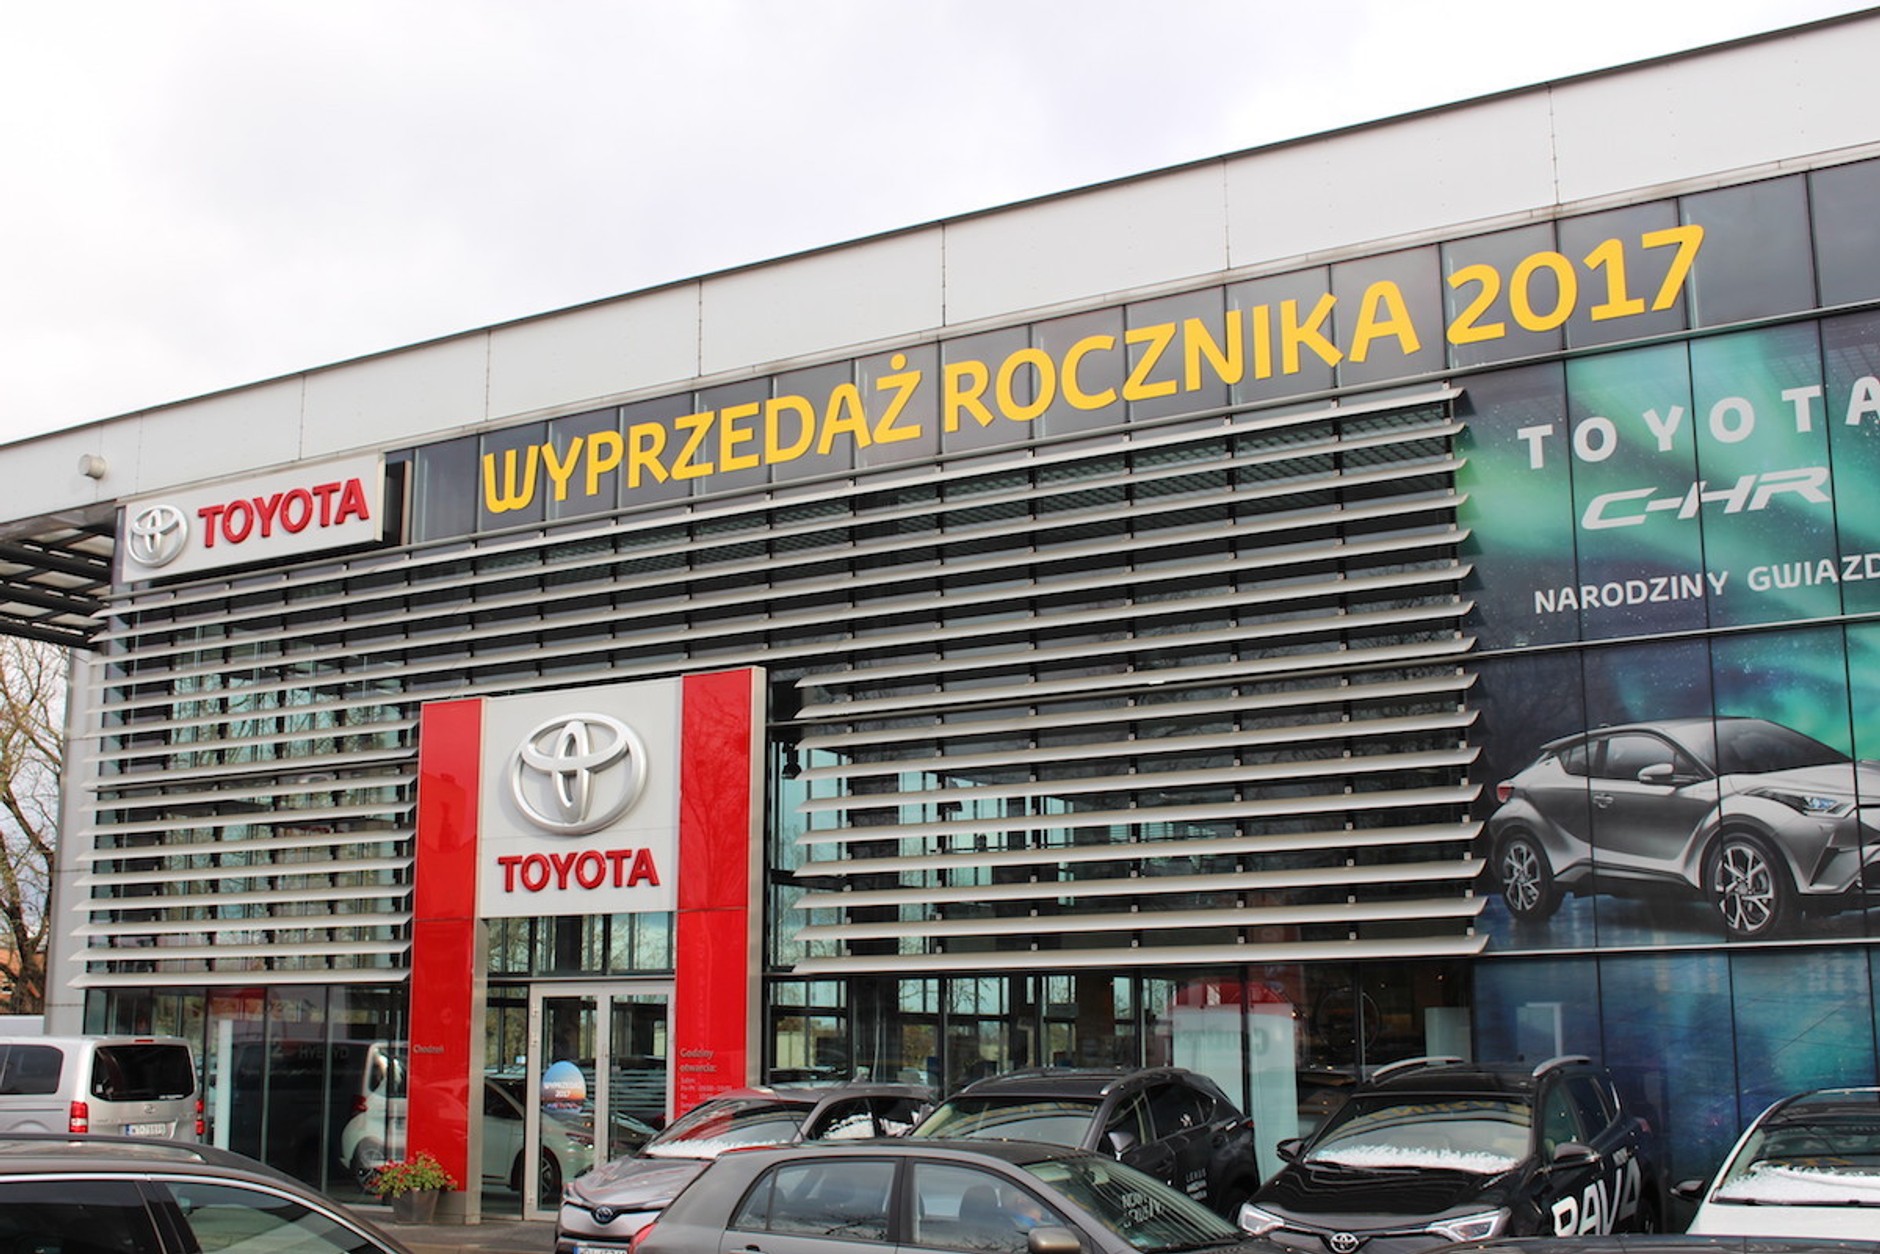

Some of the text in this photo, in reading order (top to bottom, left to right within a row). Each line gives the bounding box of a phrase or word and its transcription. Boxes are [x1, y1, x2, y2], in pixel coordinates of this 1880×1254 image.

[483, 224, 1706, 514] WYPRZEDAŻ ROCZNIKA 2017
[198, 477, 370, 549] TOYOTA
[1581, 467, 1831, 530] C-HR
[1534, 570, 1729, 615] NARODZINY
[498, 847, 661, 894] TOYOTA
